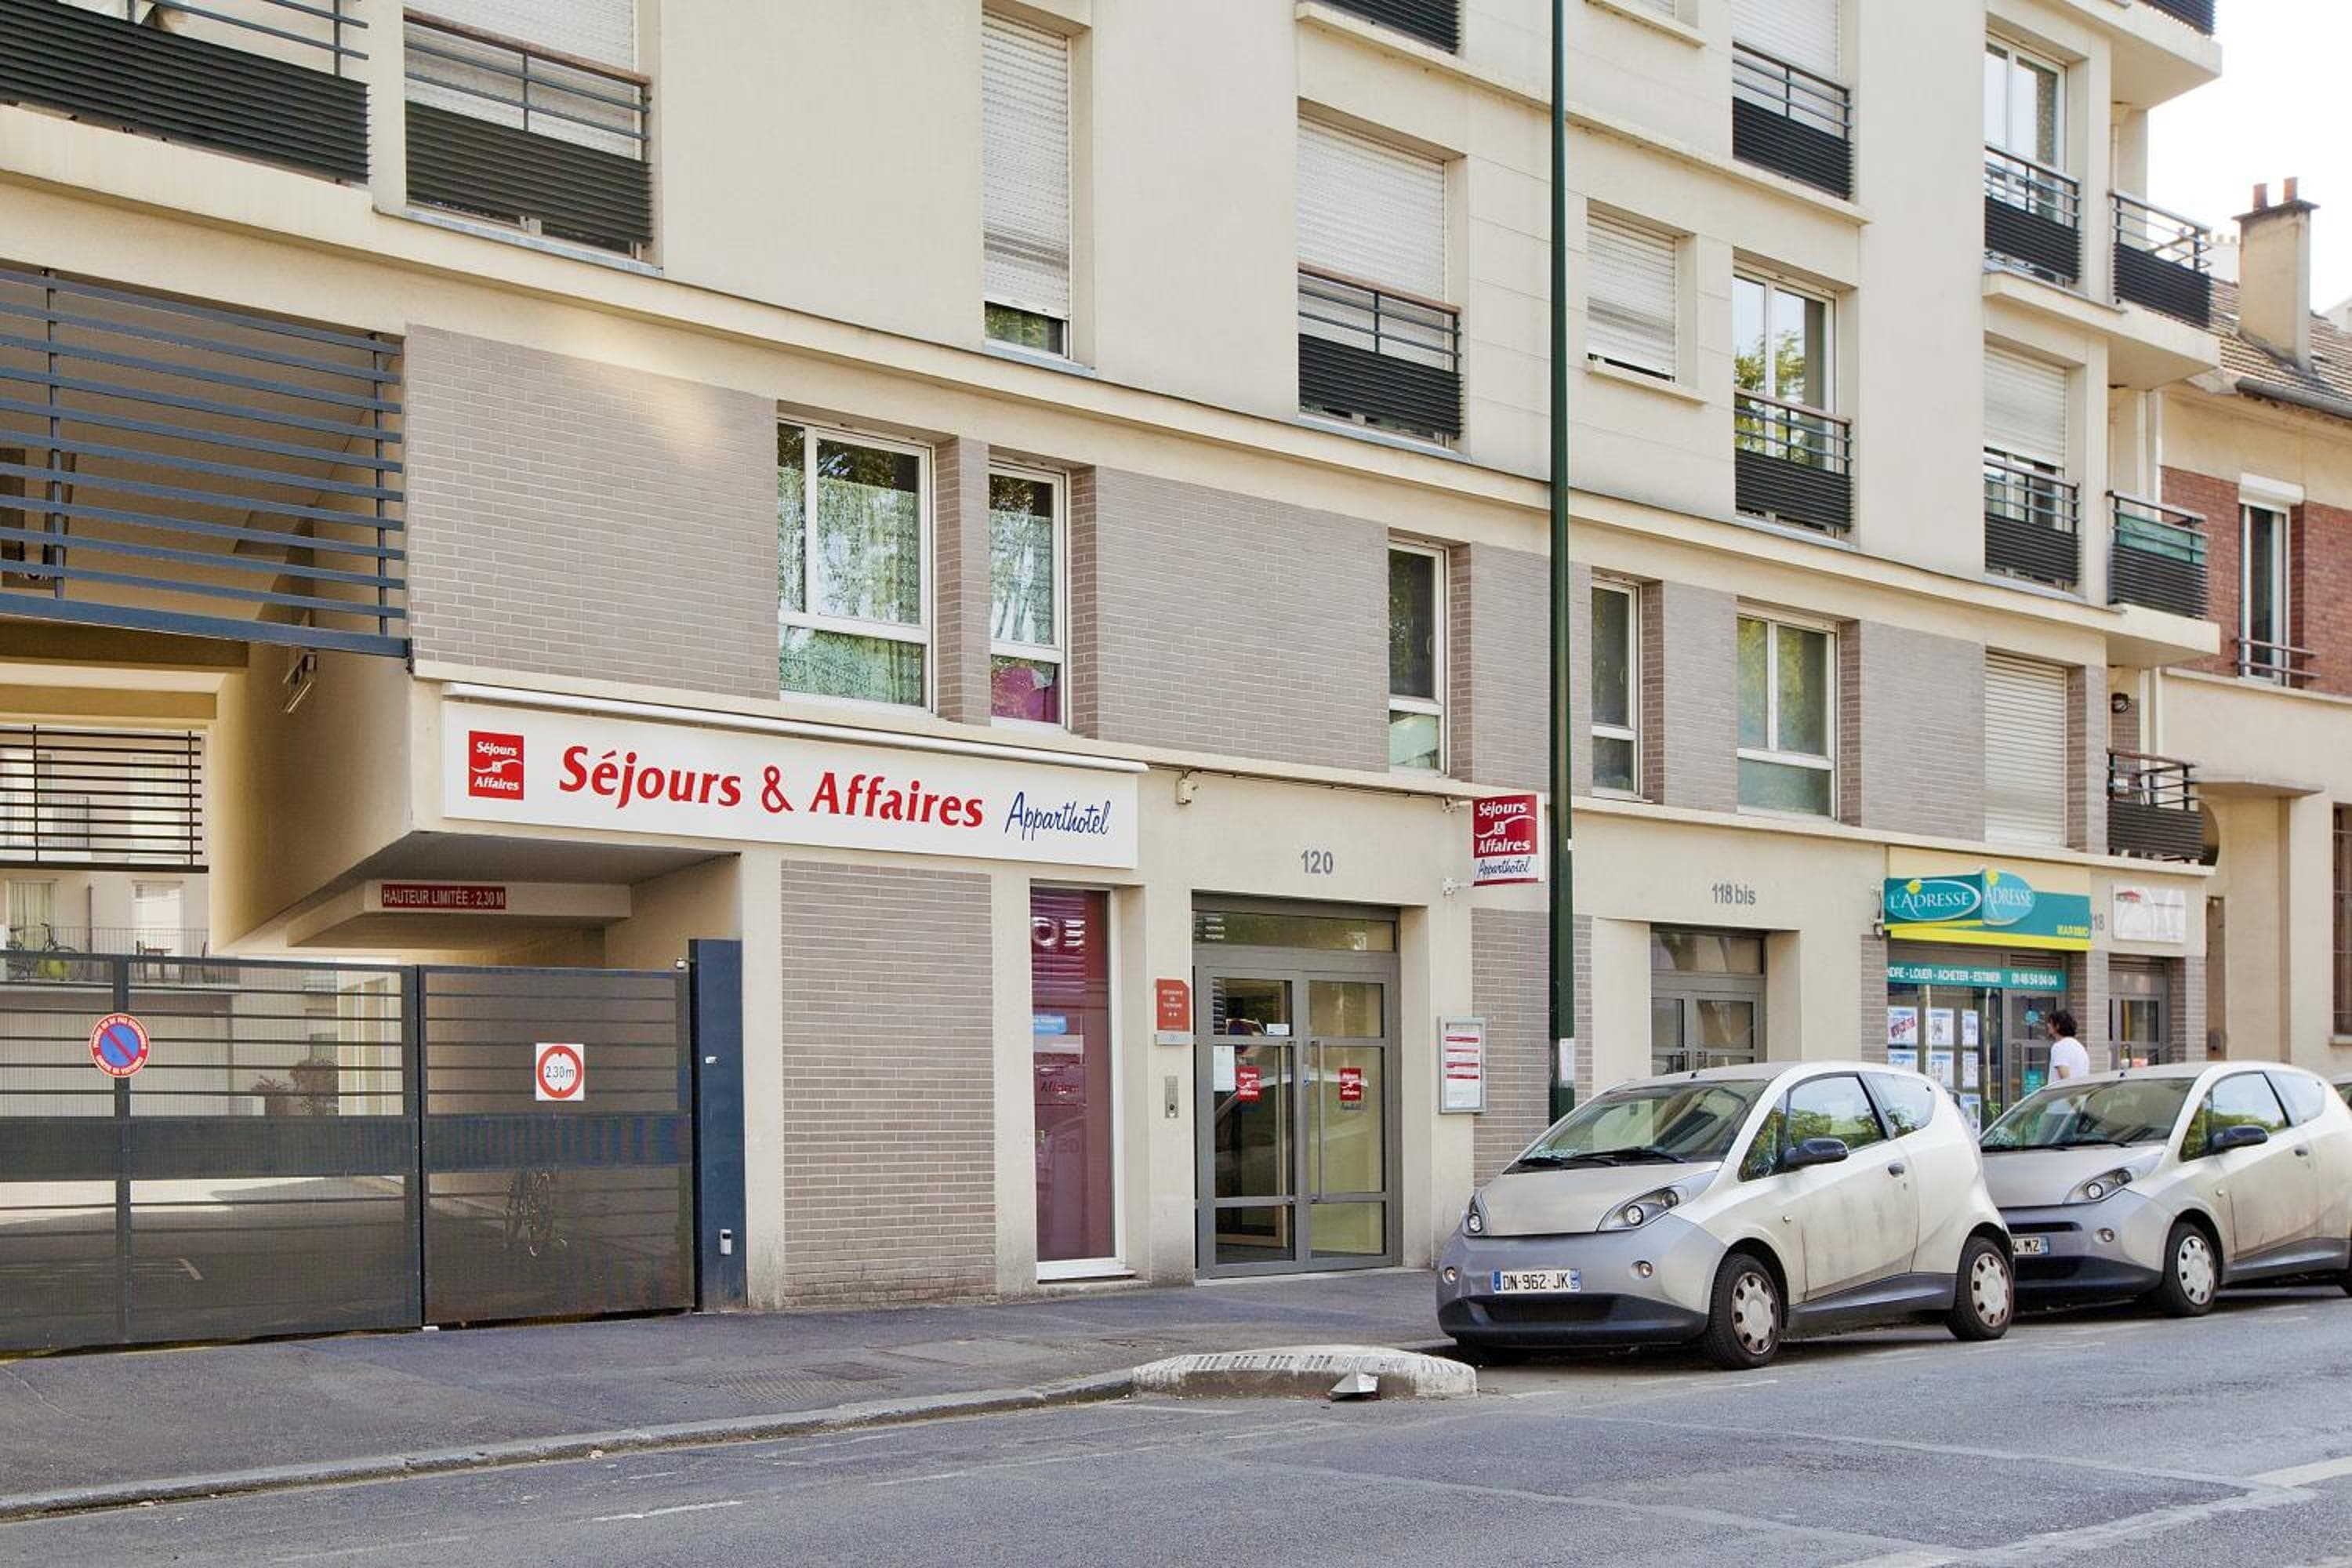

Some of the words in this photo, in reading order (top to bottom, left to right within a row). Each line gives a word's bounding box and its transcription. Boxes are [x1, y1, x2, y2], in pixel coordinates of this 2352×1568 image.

[477, 741, 518, 757] Séjours
[474, 776, 519, 791] Affaires
[559, 746, 741, 809] Séjours
[761, 764, 793, 813] &
[809, 772, 983, 827] Affaires
[1004, 791, 1111, 841] Apparthotel
[1479, 801, 1528, 818] Séjours
[1478, 838, 1531, 854] Affaires
[1301, 850, 1334, 875] 120
[1476, 856, 1531, 880] Apparthotel
[383, 889, 429, 904] HAUTEUR
[432, 887, 468, 906] LIMITÉE
[1712, 884, 1733, 904] 118
[1735, 884, 1756, 905] bis
